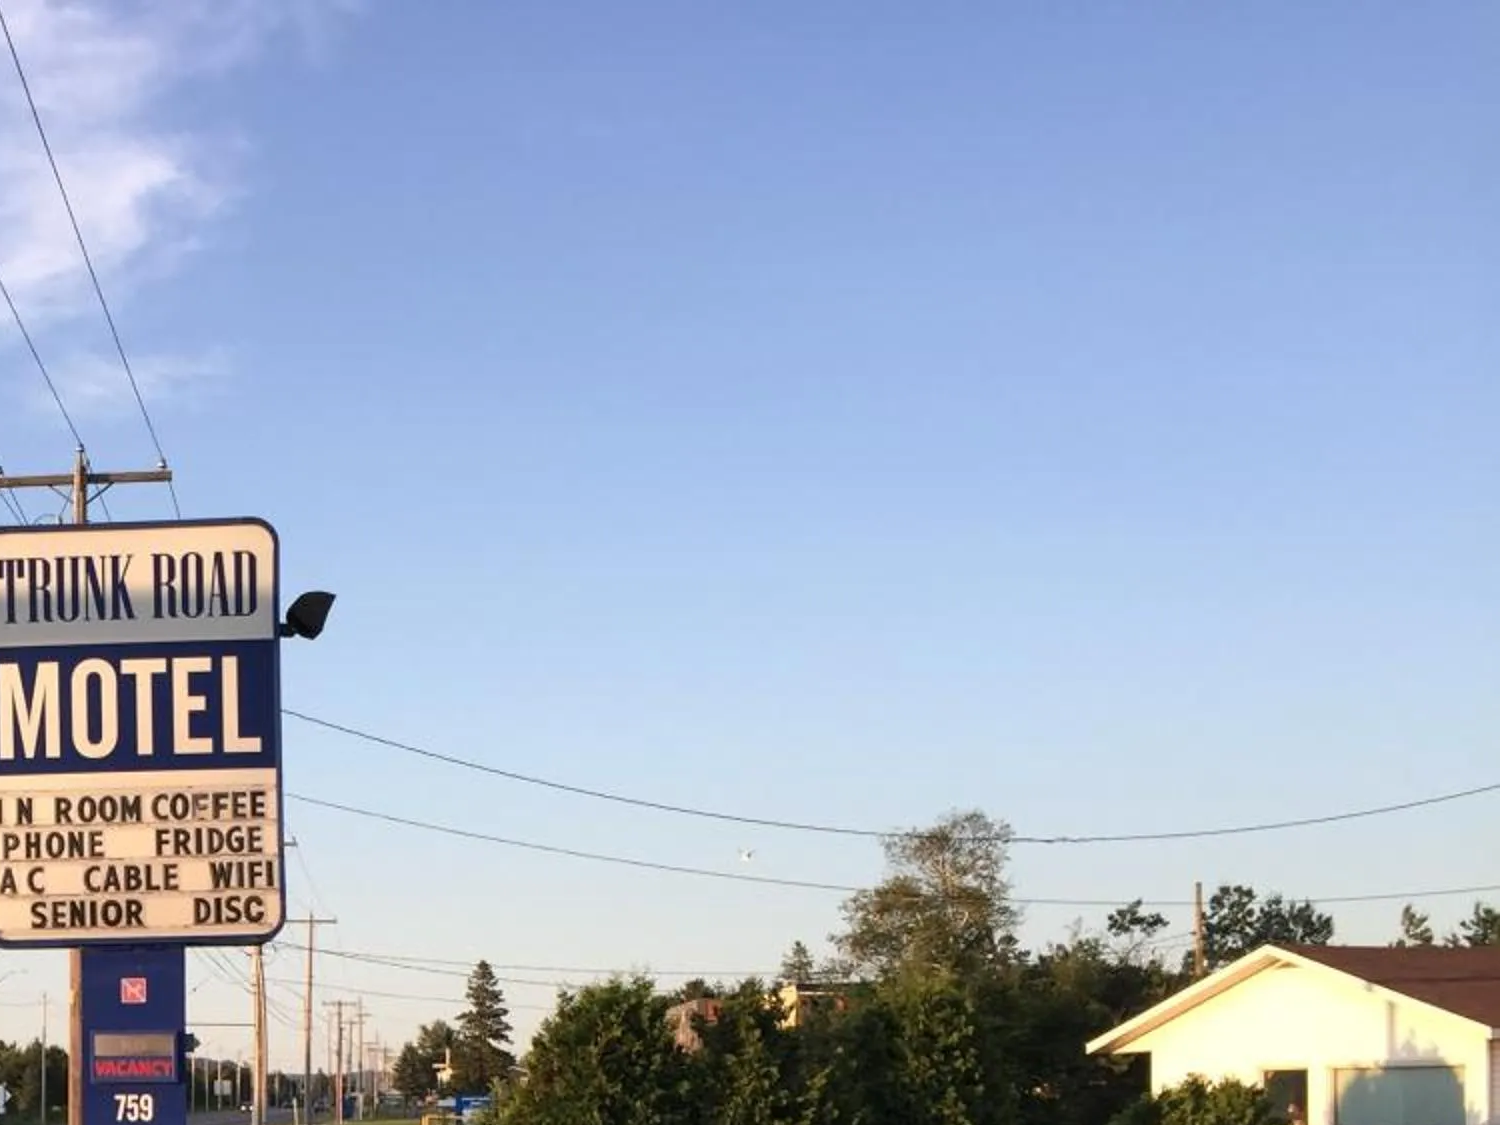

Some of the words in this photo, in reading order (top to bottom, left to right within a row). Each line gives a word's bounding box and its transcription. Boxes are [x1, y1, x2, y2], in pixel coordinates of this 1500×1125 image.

[151, 550, 258, 619] ROAD
[55, 795, 143, 824] ROOM
[151, 791, 266, 820] COFFEE
[2, 831, 106, 859] PHONE
[155, 826, 263, 856] FRIDGE
[83, 863, 179, 893] CABLE
[209, 861, 275, 889] WIFI
[31, 899, 146, 929] SENIOR
[193, 895, 265, 925] DISC
[95, 1059, 173, 1077] VACANCY
[114, 1094, 154, 1123] 759
